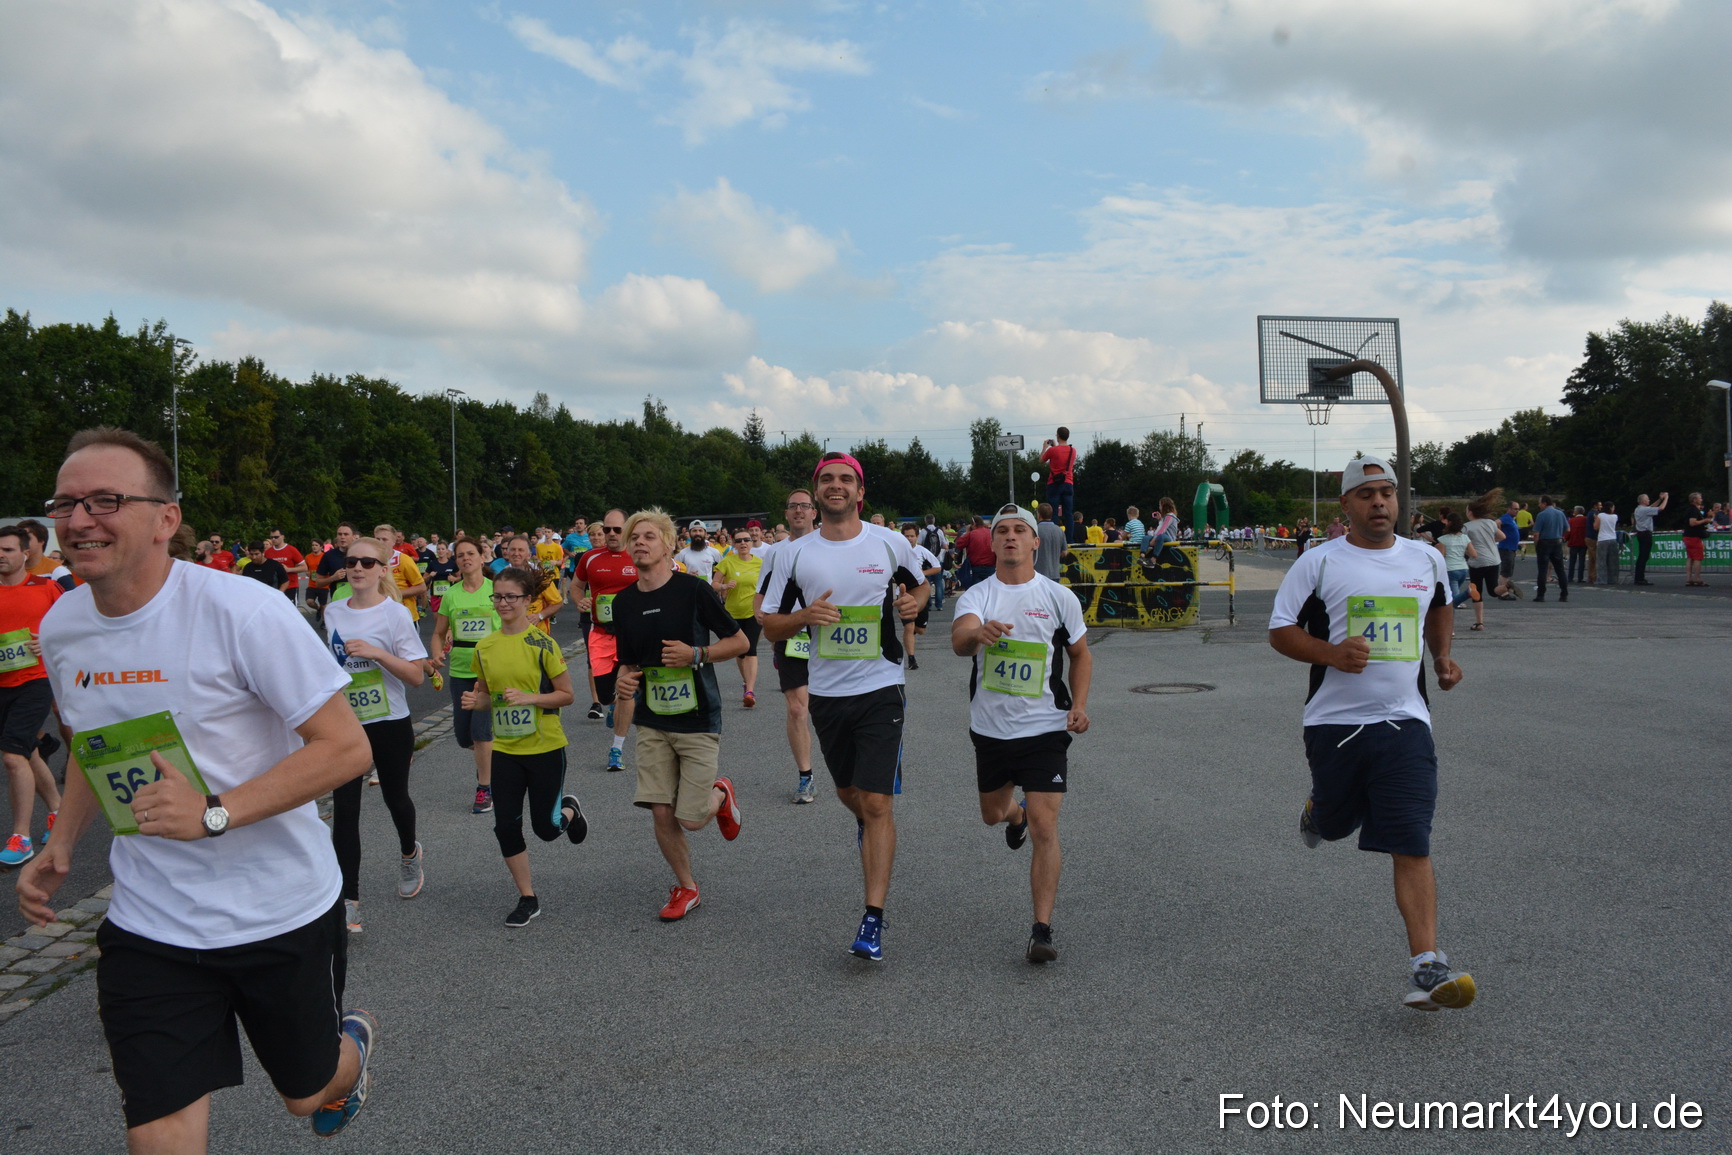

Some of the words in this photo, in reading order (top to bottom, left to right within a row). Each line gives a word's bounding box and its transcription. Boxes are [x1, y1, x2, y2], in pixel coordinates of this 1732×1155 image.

[461, 620, 486, 632] 222
[1362, 621, 1402, 643] 411
[830, 626, 869, 645] 408
[346, 660, 370, 669] eam
[994, 660, 1032, 681] 410
[93, 669, 169, 686] KLEBL
[345, 688, 382, 708] 583
[651, 683, 691, 701] 1224
[495, 708, 532, 726] 1182
